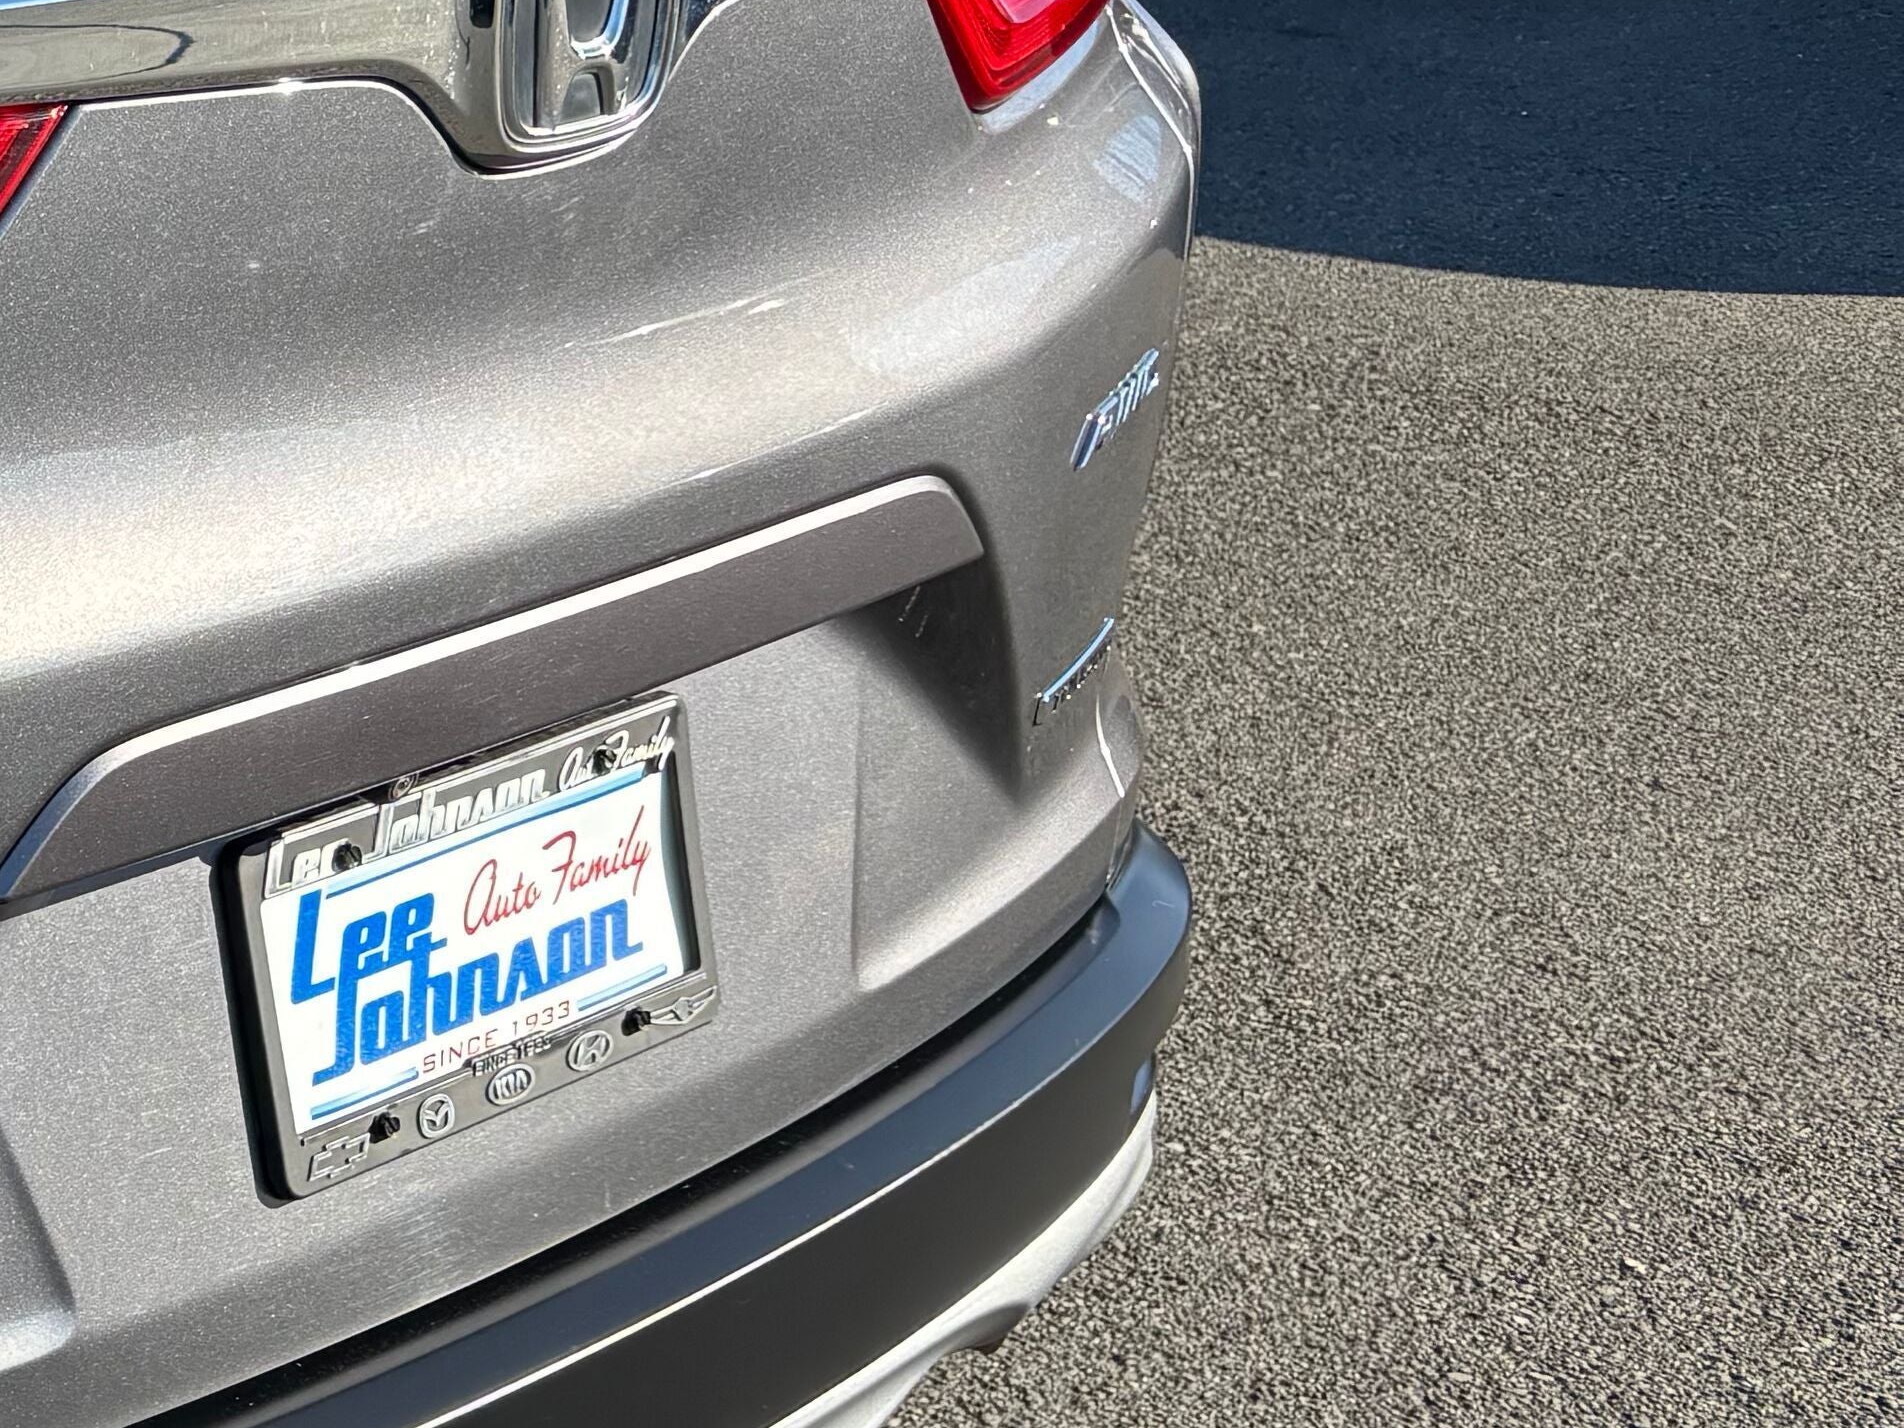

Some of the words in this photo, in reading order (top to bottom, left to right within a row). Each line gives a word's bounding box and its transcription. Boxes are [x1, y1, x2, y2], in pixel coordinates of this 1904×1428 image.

[362, 767, 550, 865] Johnson
[558, 746, 604, 791] Aut
[291, 889, 447, 1004] Lee
[463, 858, 542, 936] Auto
[542, 804, 651, 906] Family
[312, 898, 644, 1087] Johnson
[422, 1028, 499, 1073] SINCE
[512, 999, 570, 1036] 1933
